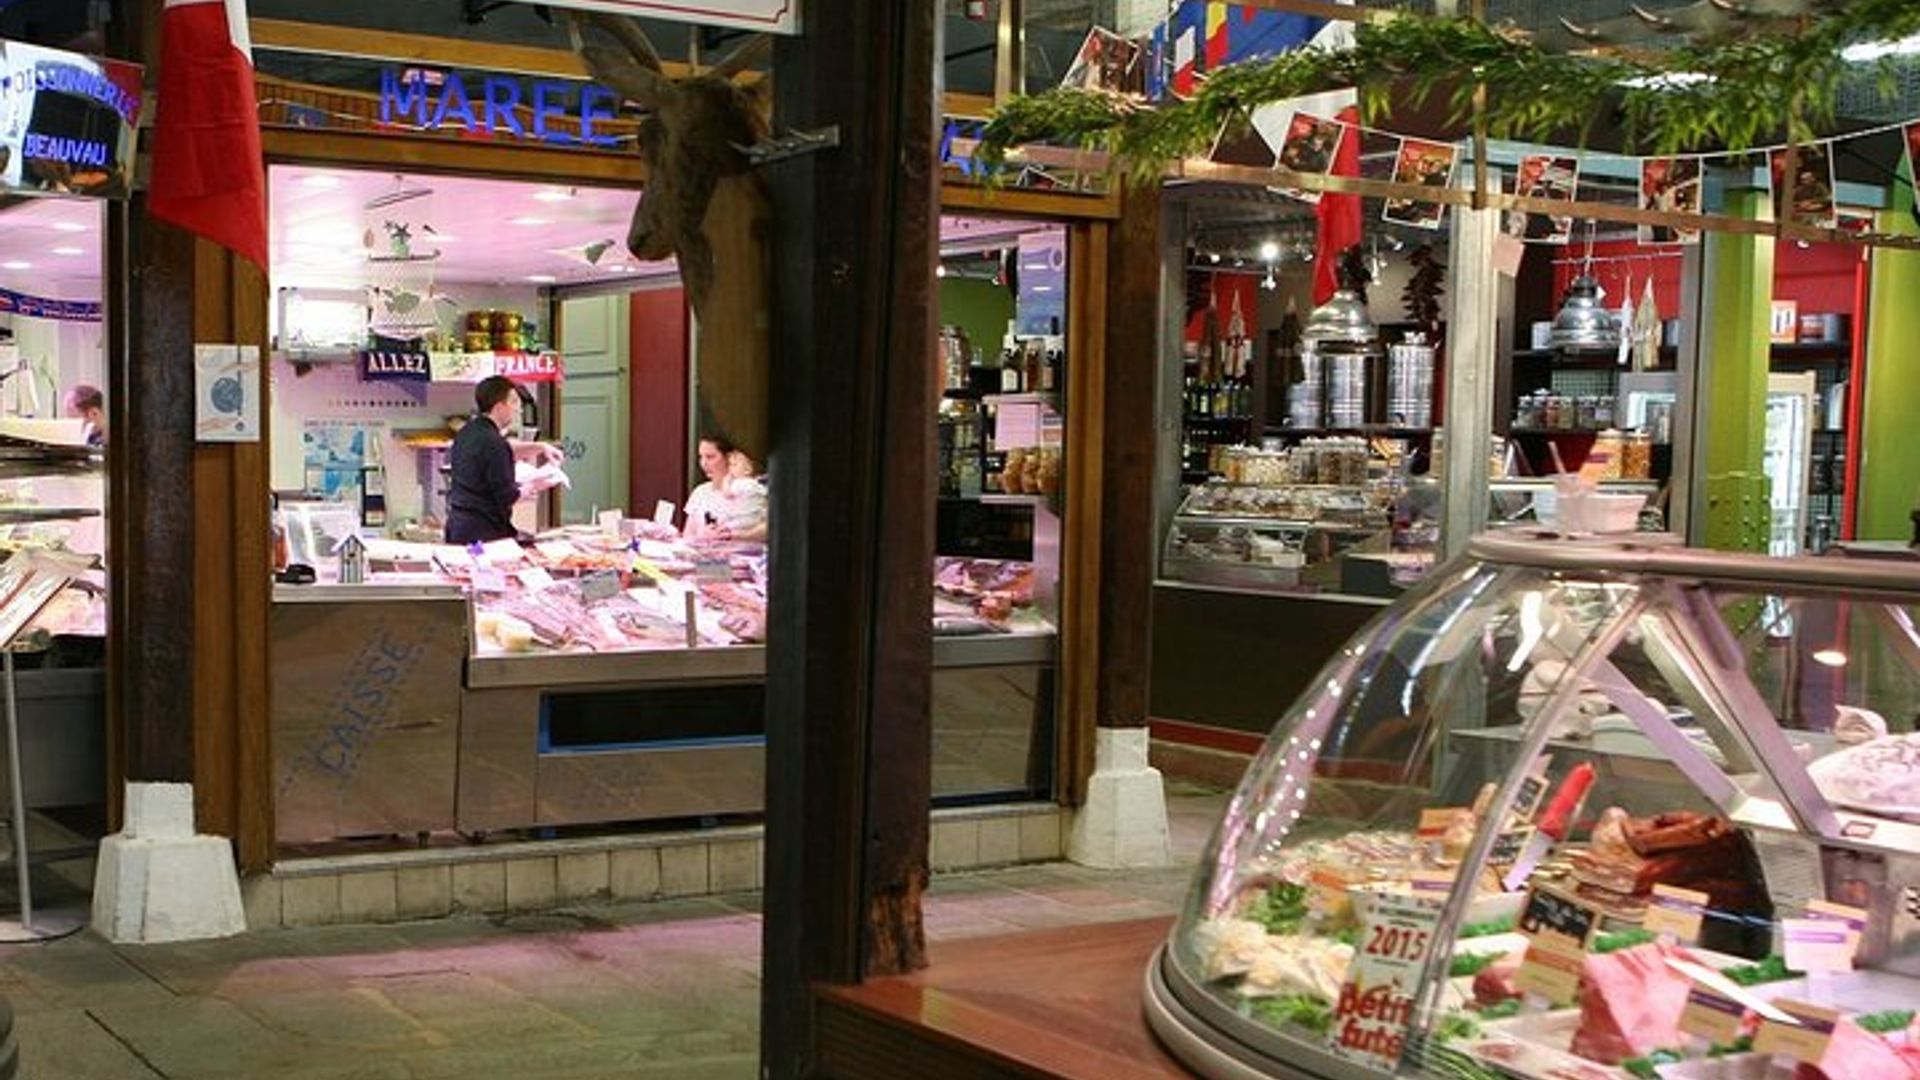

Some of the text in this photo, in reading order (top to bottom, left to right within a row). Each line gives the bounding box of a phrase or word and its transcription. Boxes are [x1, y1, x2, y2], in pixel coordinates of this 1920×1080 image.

[379, 68, 617, 144] MAREE
[24, 134, 107, 166] BEAUVAU
[368, 354, 557, 375] ALLEZ FRANCE
[316, 631, 409, 774] CAISSE
[1365, 923, 1429, 962] 2015
